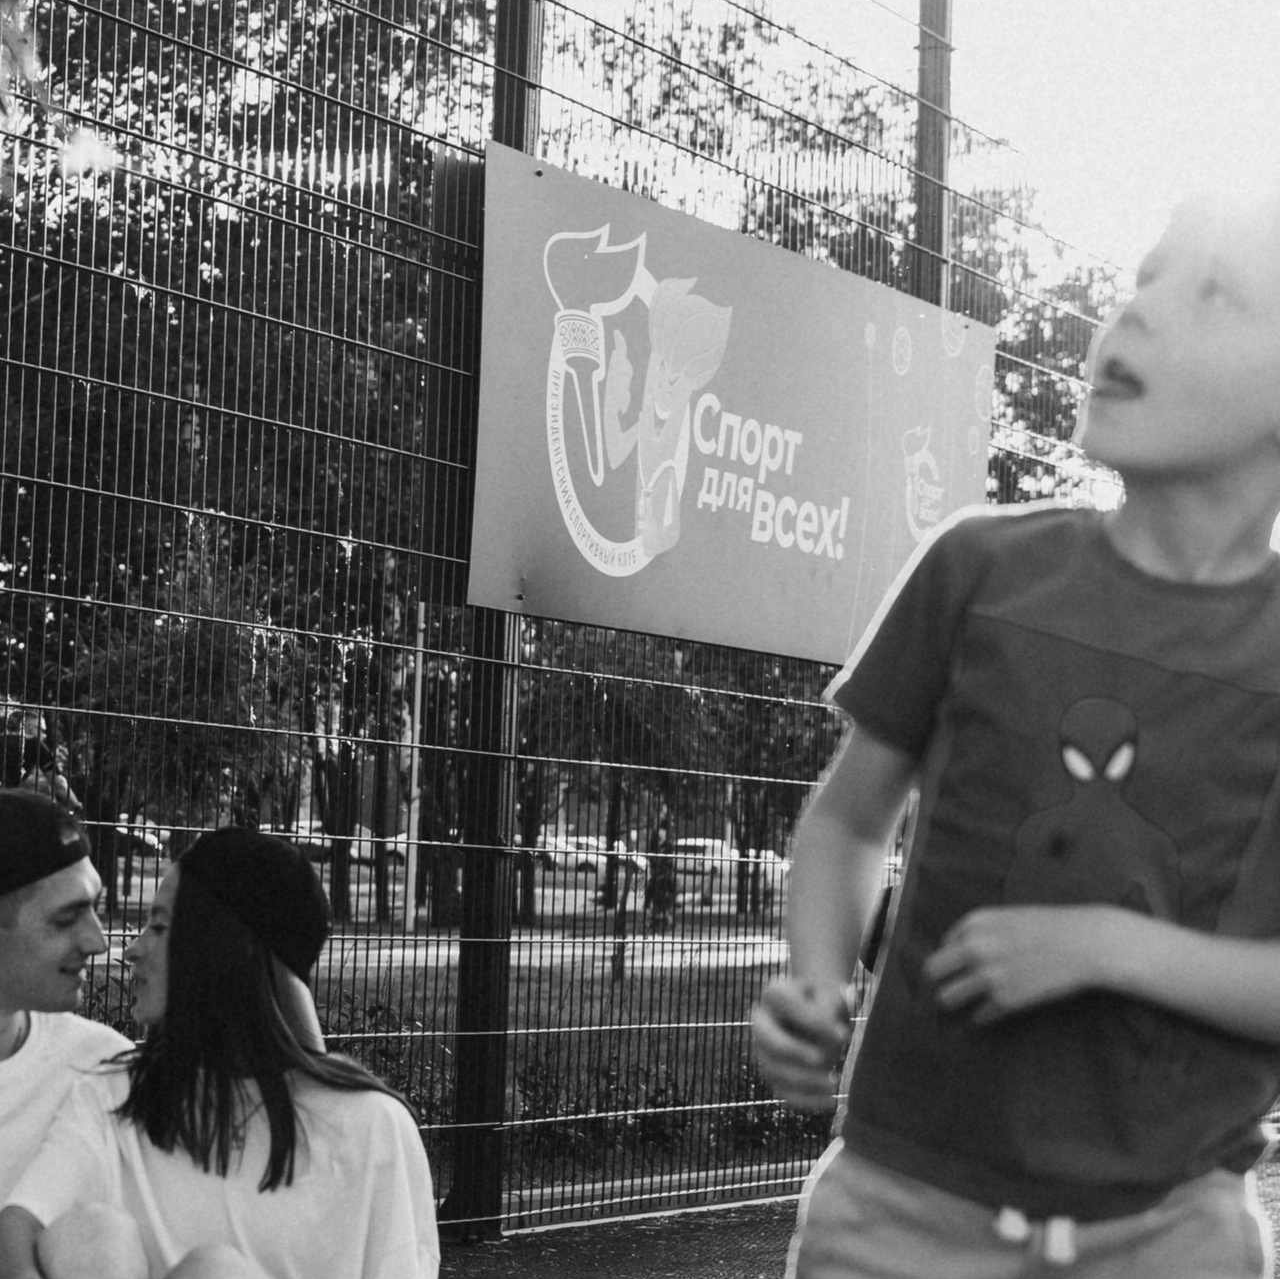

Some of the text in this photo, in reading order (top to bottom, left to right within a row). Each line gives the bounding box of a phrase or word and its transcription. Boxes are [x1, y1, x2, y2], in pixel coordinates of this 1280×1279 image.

[550, 369, 637, 568] ПРЕЗИДЕНТСКИЙ СПОРТИВНЫЙ КЛУБ
[693, 392, 803, 485] Спорт
[697, 466, 754, 513] для
